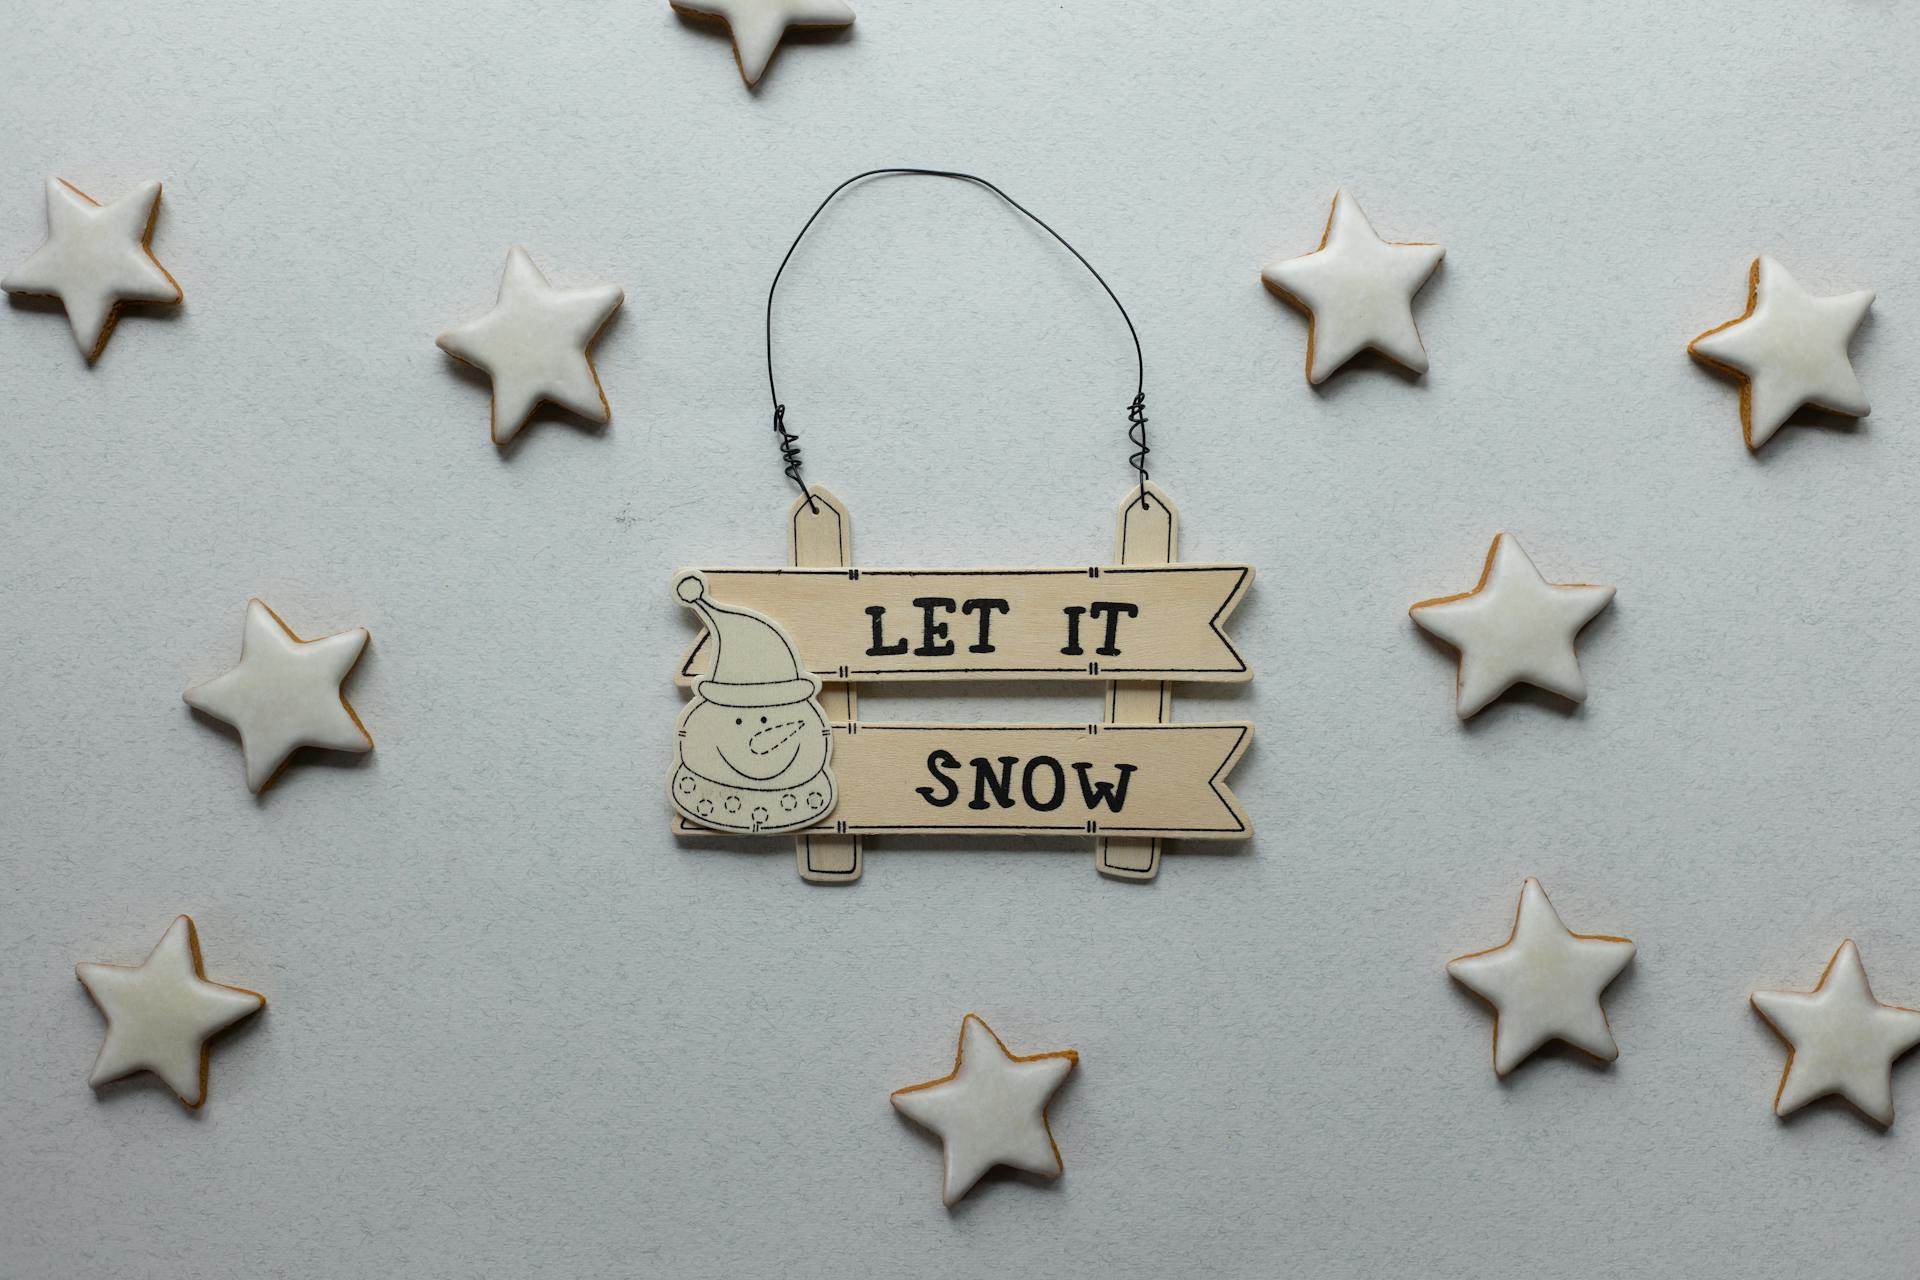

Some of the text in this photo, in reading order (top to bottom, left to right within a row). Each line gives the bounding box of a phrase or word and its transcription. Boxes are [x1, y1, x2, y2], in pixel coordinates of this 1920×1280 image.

[865, 597, 1139, 656] LET IT
[915, 750, 1138, 813] SNOW
